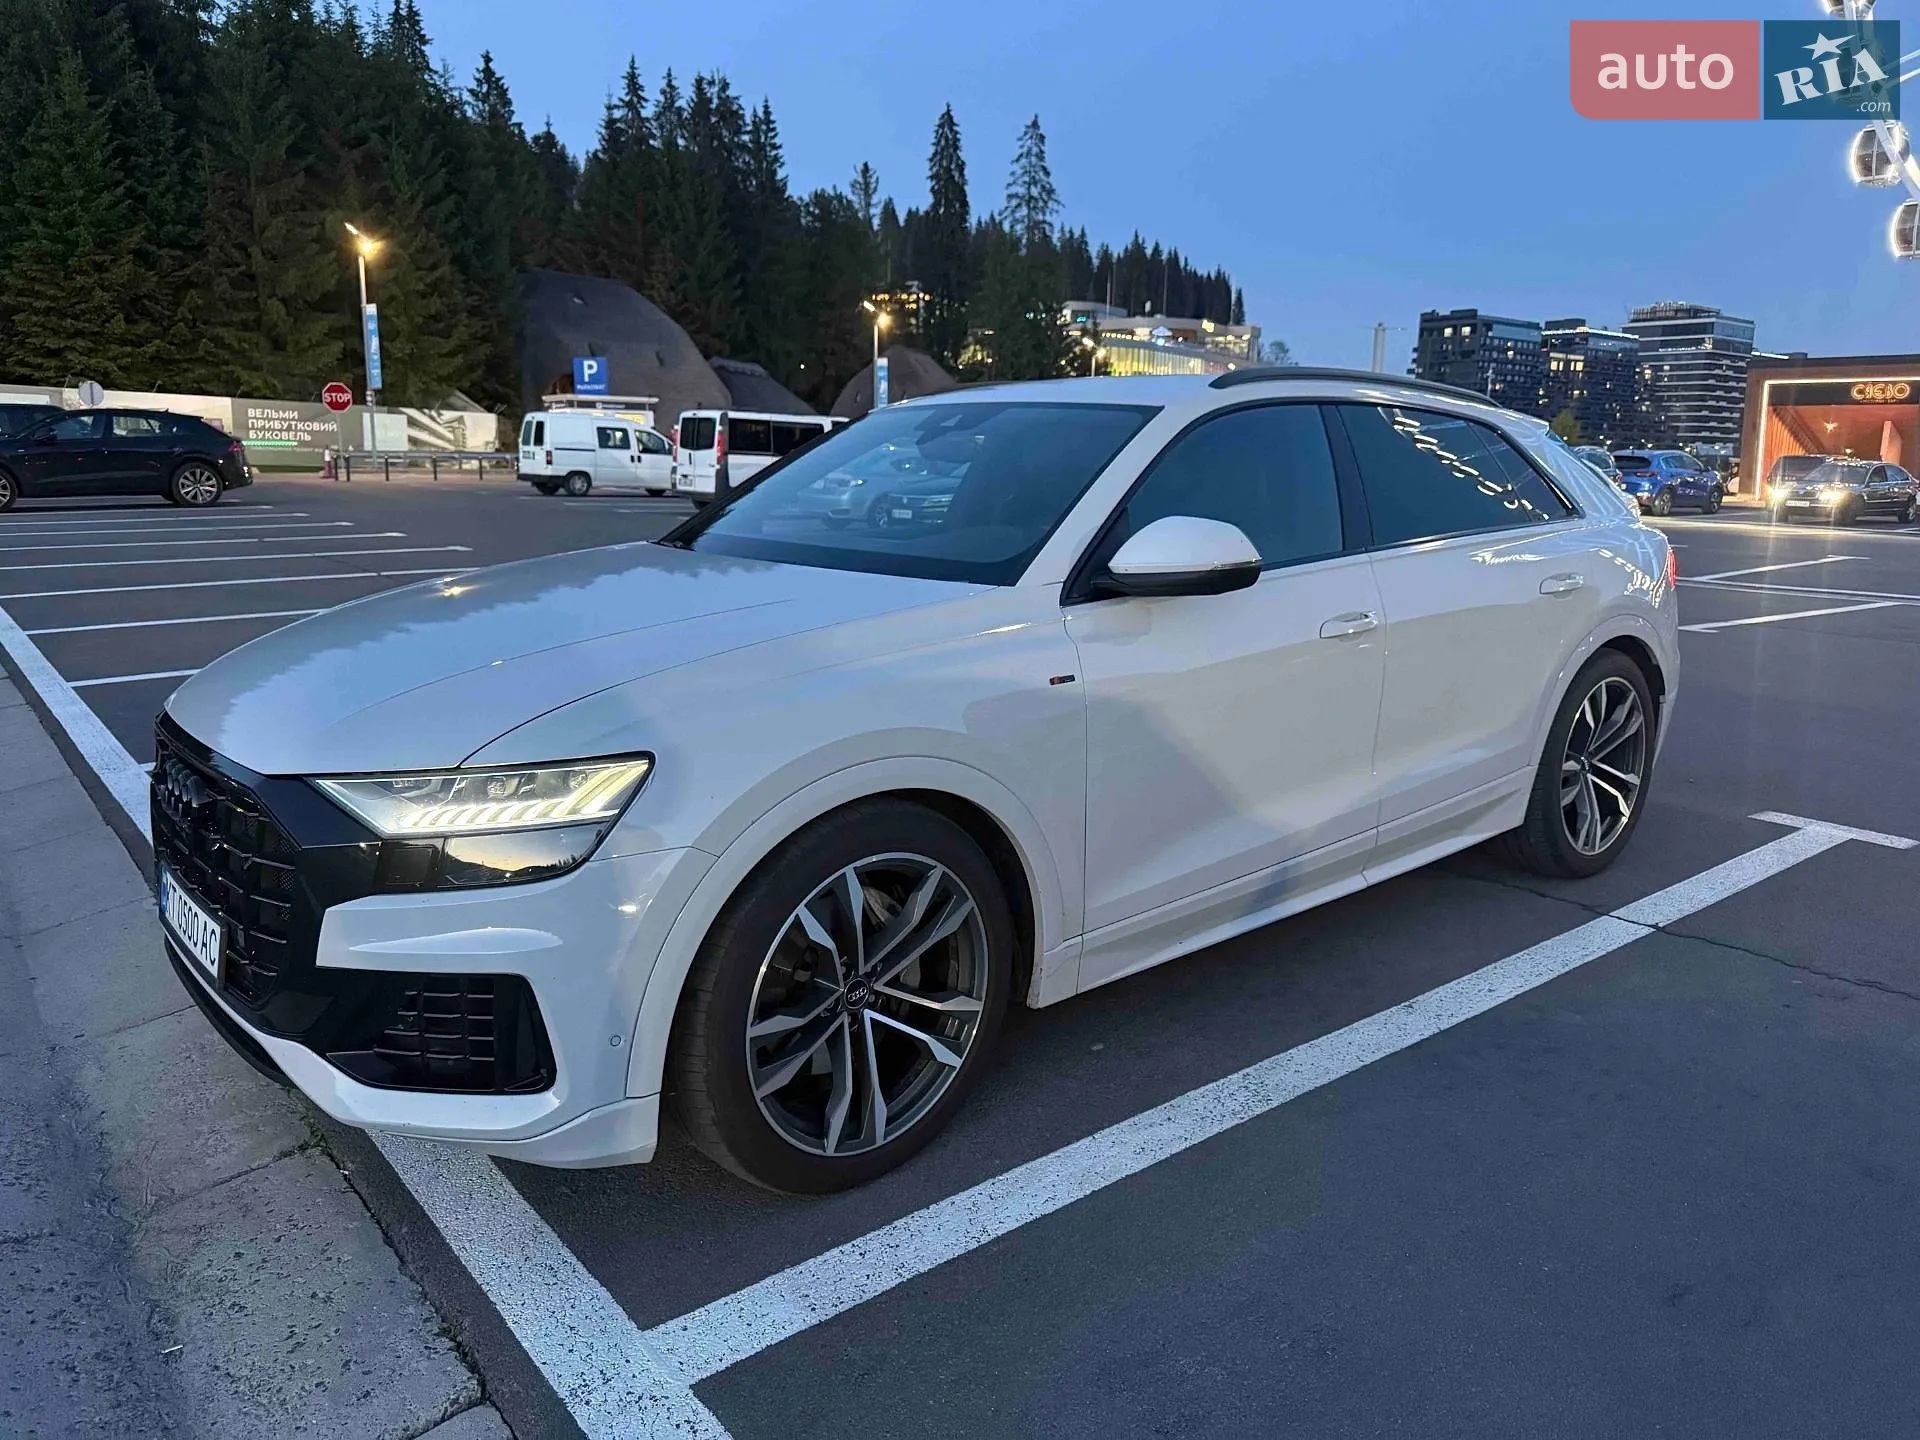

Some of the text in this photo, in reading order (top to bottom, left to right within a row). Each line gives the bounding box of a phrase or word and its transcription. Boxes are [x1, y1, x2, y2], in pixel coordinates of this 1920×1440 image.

[583, 360, 598, 382] P
[324, 392, 350, 403] STOP
[247, 408, 299, 420] ВЕЛЬМИ
[248, 419, 338, 432] ПРИБУТКОВИЙ
[249, 430, 312, 441] БУКОВЕЛЬ
[178, 894, 199, 948] 0500
[201, 920, 217, 966] AC
